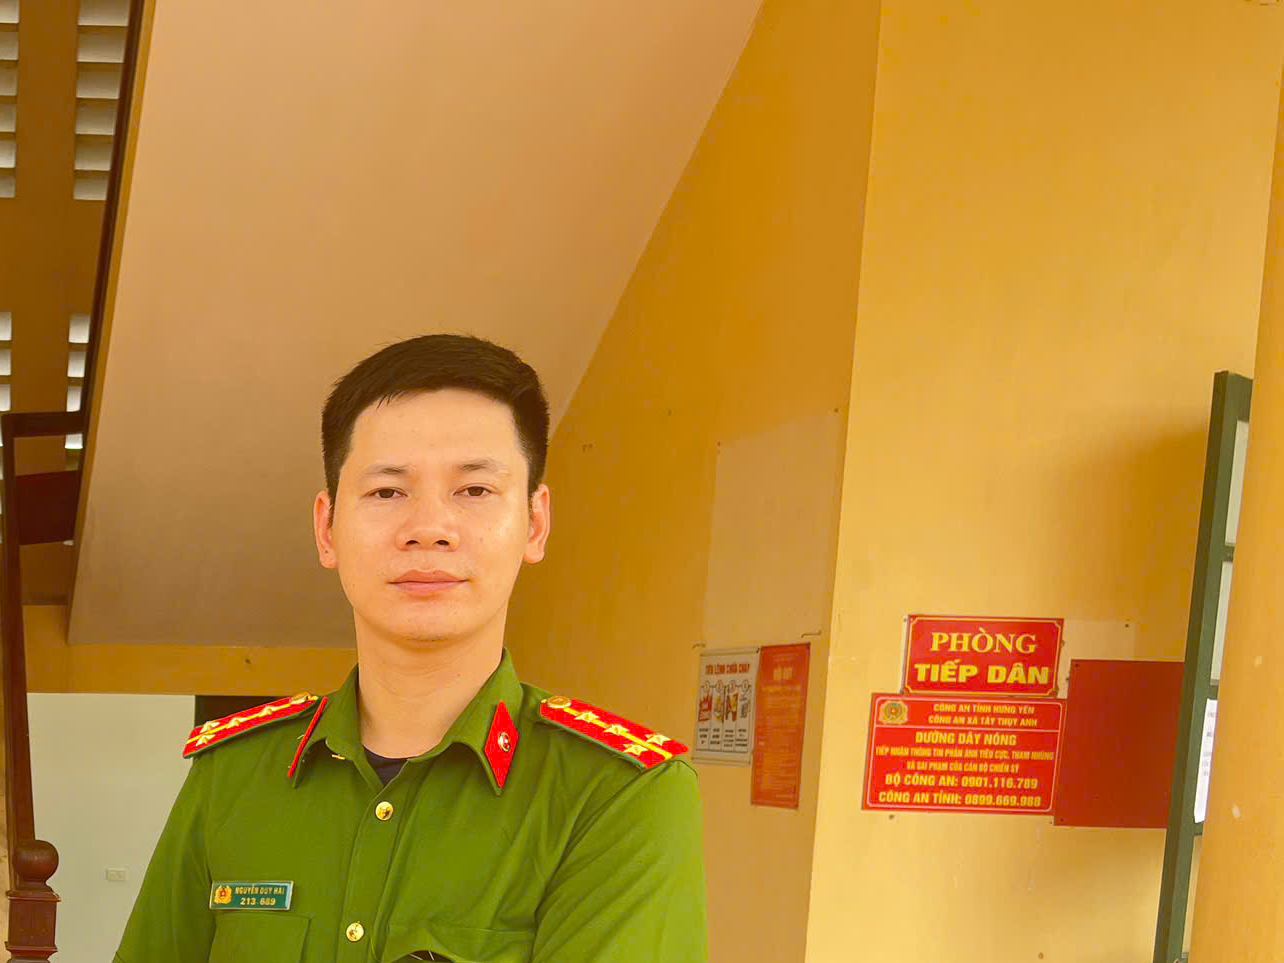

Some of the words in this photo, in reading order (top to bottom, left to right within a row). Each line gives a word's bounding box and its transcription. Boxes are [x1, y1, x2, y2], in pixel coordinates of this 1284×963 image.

[930, 626, 1037, 654] PHÒNG
[914, 658, 978, 683] TIẾP
[987, 662, 1050, 684] DÂN
[958, 730, 980, 745] DÂY
[984, 731, 1017, 746] NÓNG
[885, 773, 901, 787] BỘ
[904, 772, 935, 786] CÔNG
[939, 775, 959, 787] AN:
[879, 790, 910, 803] CÔNG
[913, 793, 929, 803] AN
